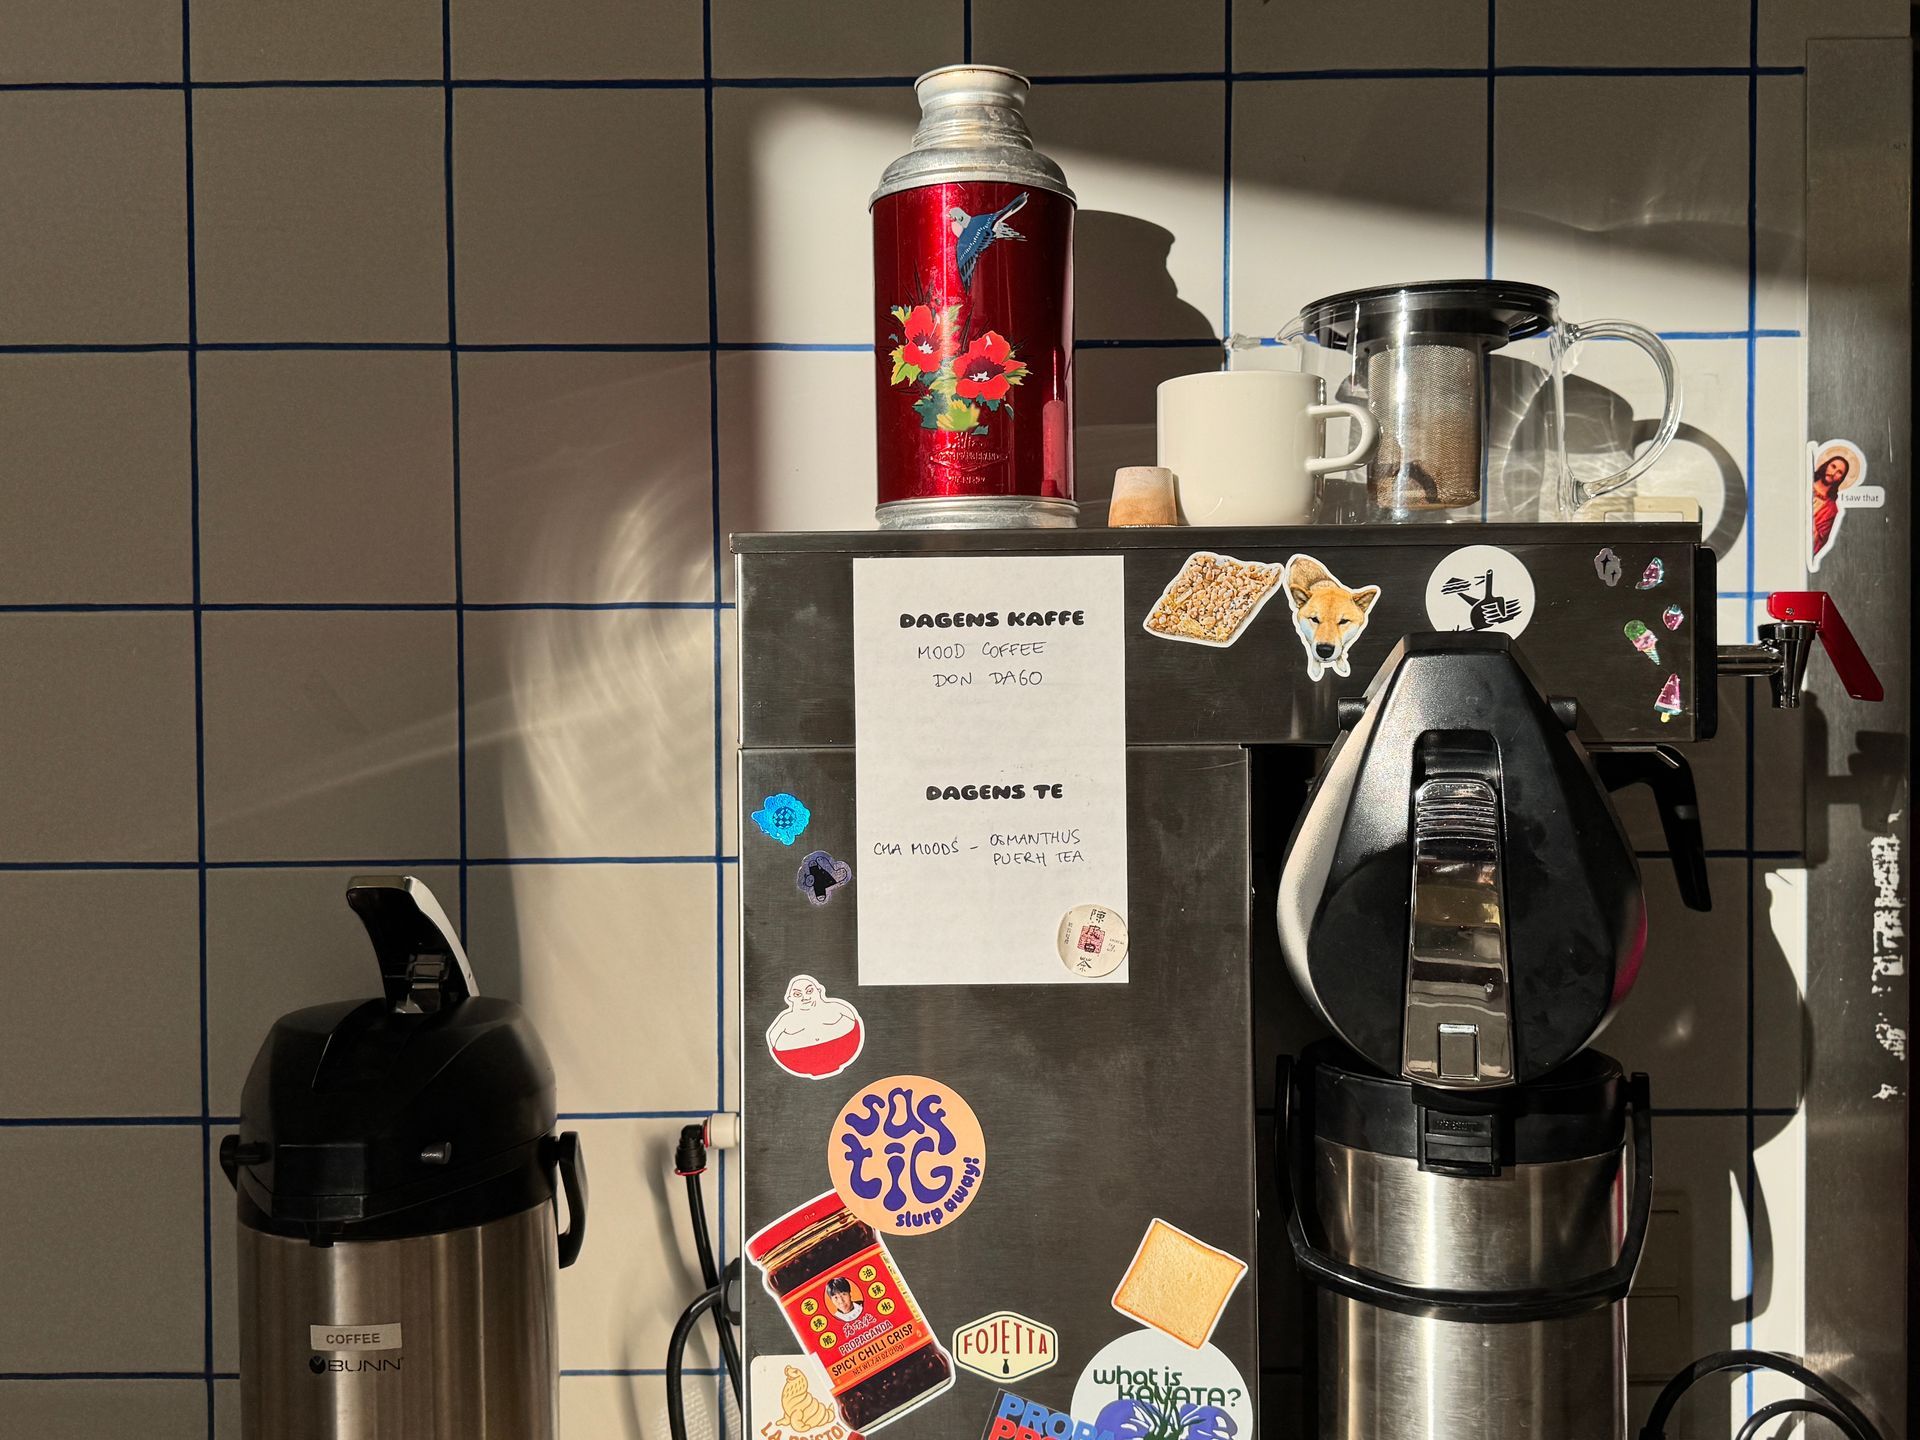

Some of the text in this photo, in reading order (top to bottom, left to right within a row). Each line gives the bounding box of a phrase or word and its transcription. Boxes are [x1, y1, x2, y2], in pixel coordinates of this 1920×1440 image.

[1862, 494, 1879, 502] that
[899, 610, 1085, 628] DAGENS KAFFE
[917, 641, 1048, 660] MOOD COFFEE
[932, 672, 973, 687] DON
[925, 783, 1064, 801] DAGENS TE
[989, 829, 1081, 847] OSMANTHUS
[873, 842, 902, 855] CHA
[992, 850, 1085, 867] PUERH TEA
[895, 1156, 982, 1228] slurp away!
[325, 1332, 381, 1345] COFFEE
[838, 1320, 894, 1357] PROPAGANDA
[963, 1319, 1048, 1355] FOJETTA
[831, 1355, 857, 1377] SPICY
[858, 1339, 888, 1361] CHILI
[887, 1323, 914, 1345] CRISP
[328, 1358, 401, 1373] BUNN
[1093, 1365, 1182, 1386] what is
